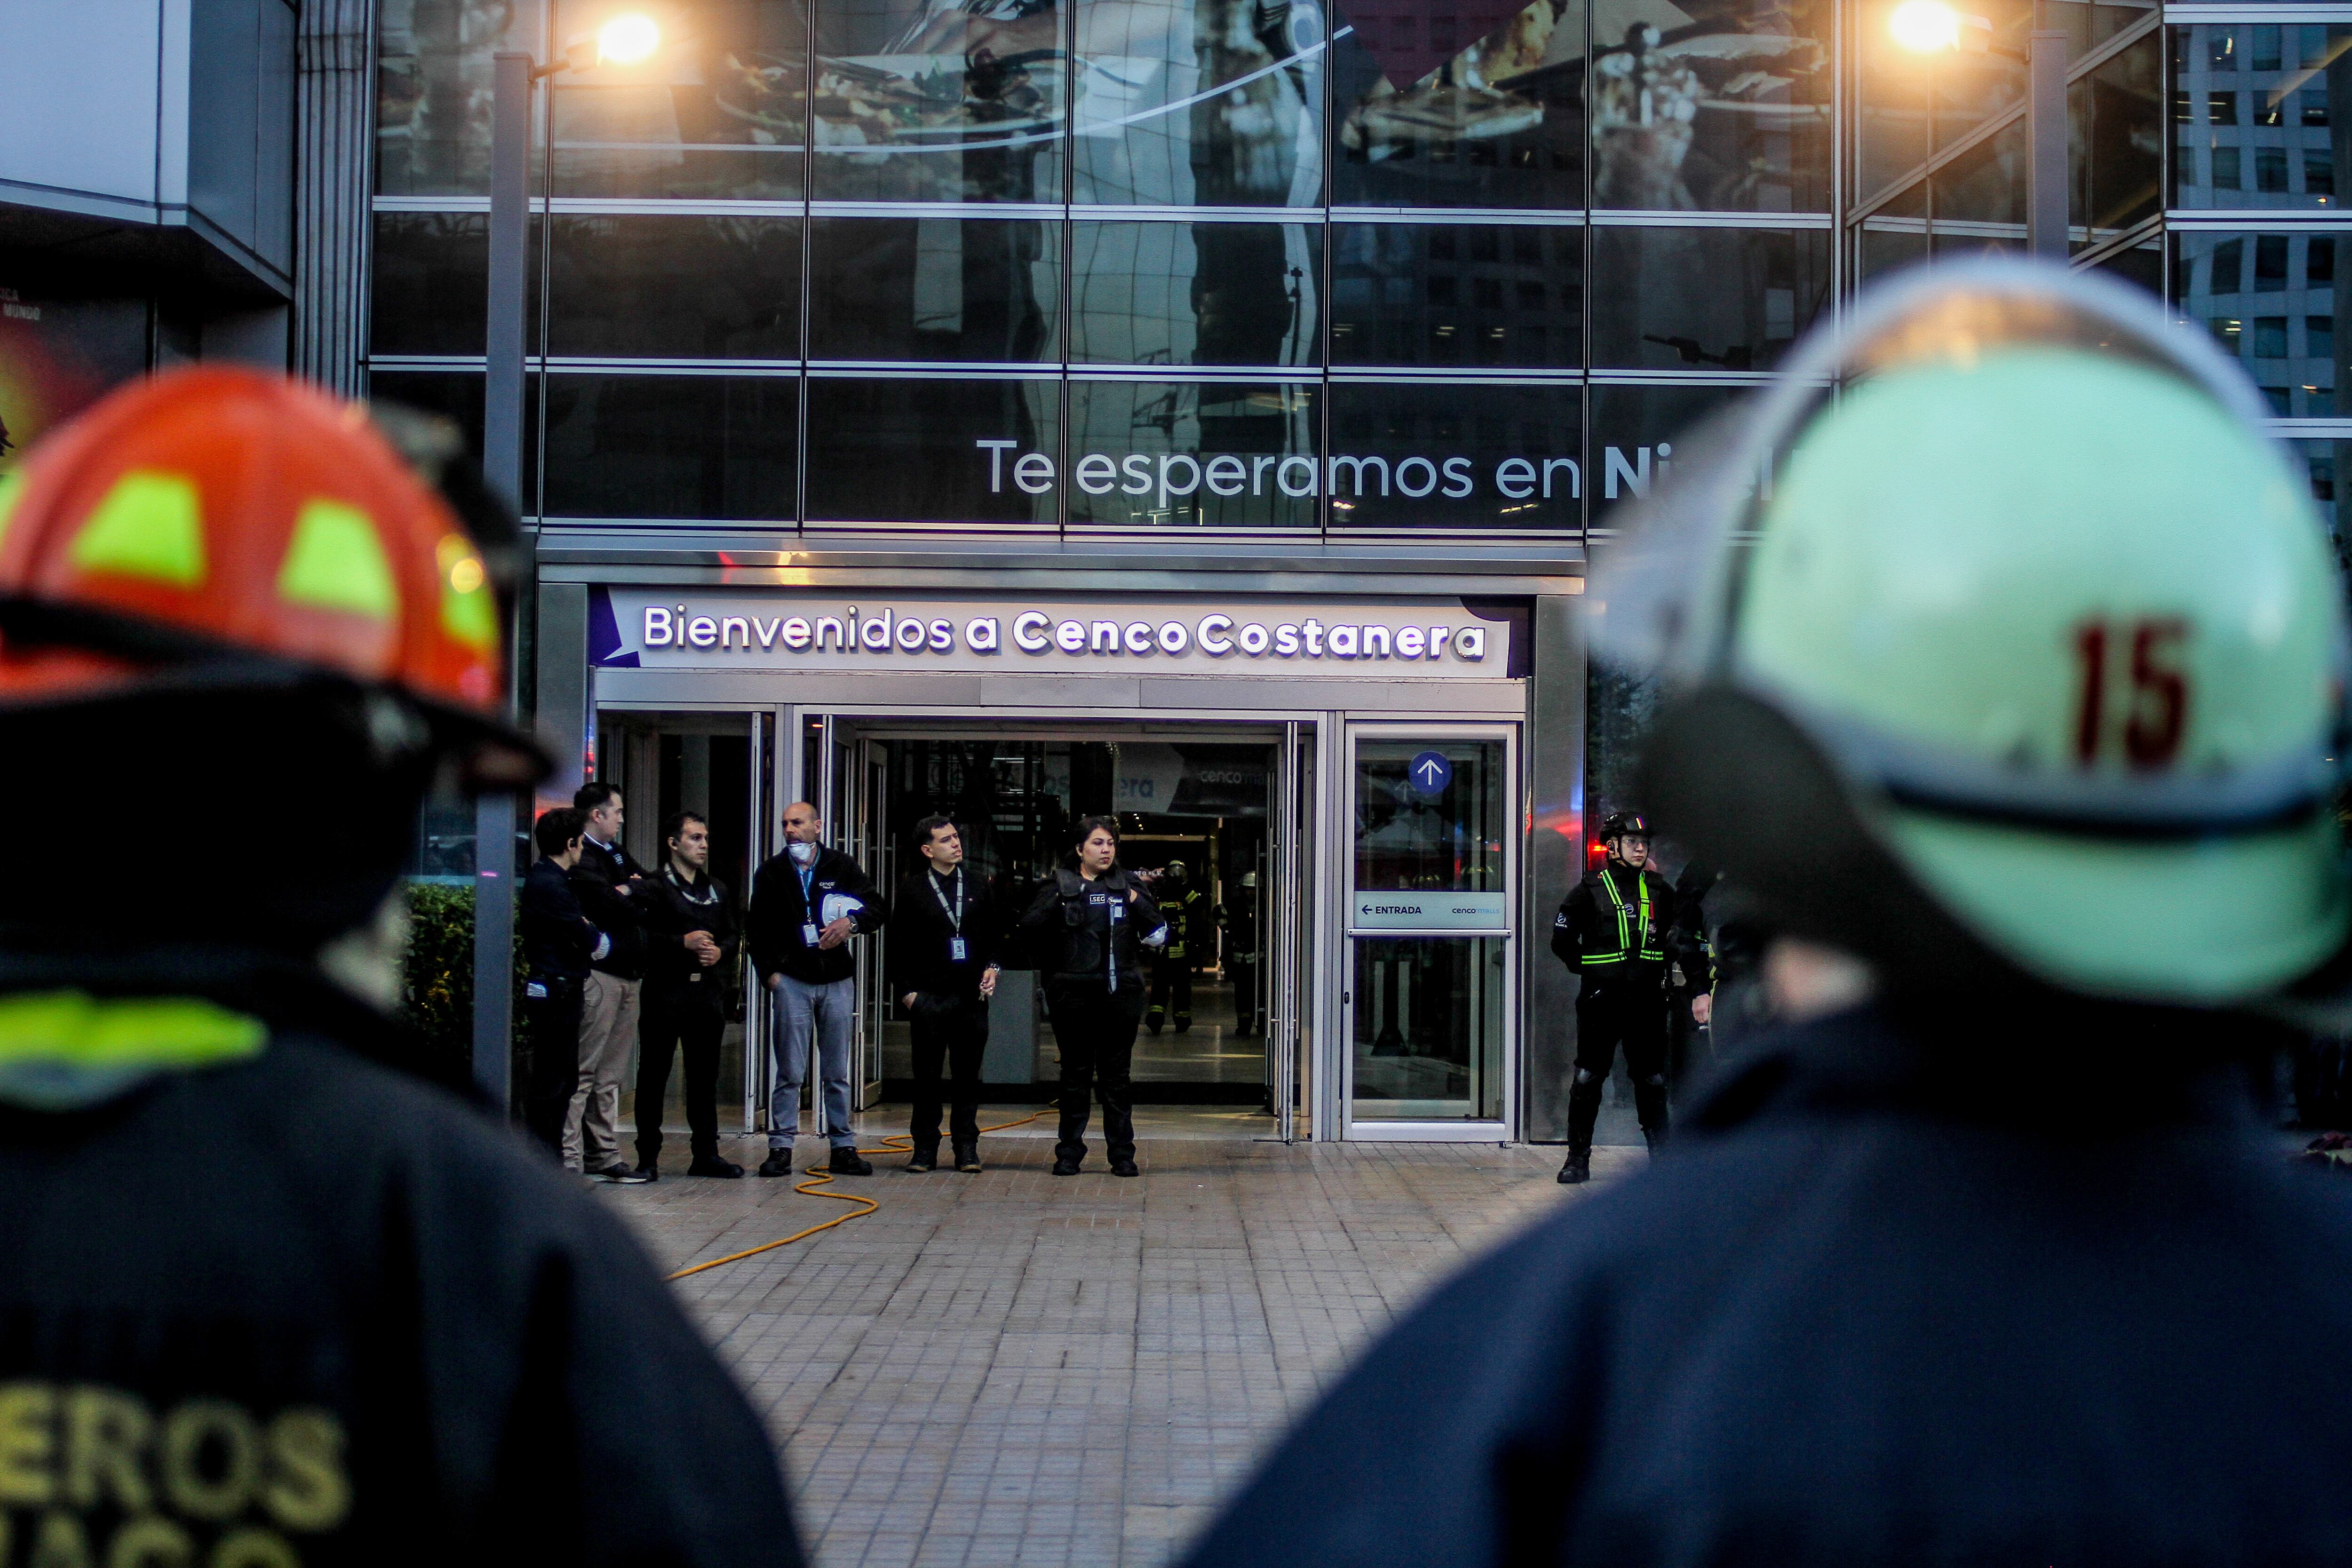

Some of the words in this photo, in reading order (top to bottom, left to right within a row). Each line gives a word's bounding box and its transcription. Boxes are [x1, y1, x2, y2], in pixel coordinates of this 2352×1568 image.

[976, 439, 1055, 494] Te
[1076, 453, 1473, 509] esperamos
[1495, 458, 1580, 498] en
[644, 604, 953, 651] Bienvenidos
[964, 617, 998, 651] a
[1012, 610, 1189, 654] Cenco
[1196, 613, 1486, 658] Costanera
[2071, 617, 2195, 771] 15
